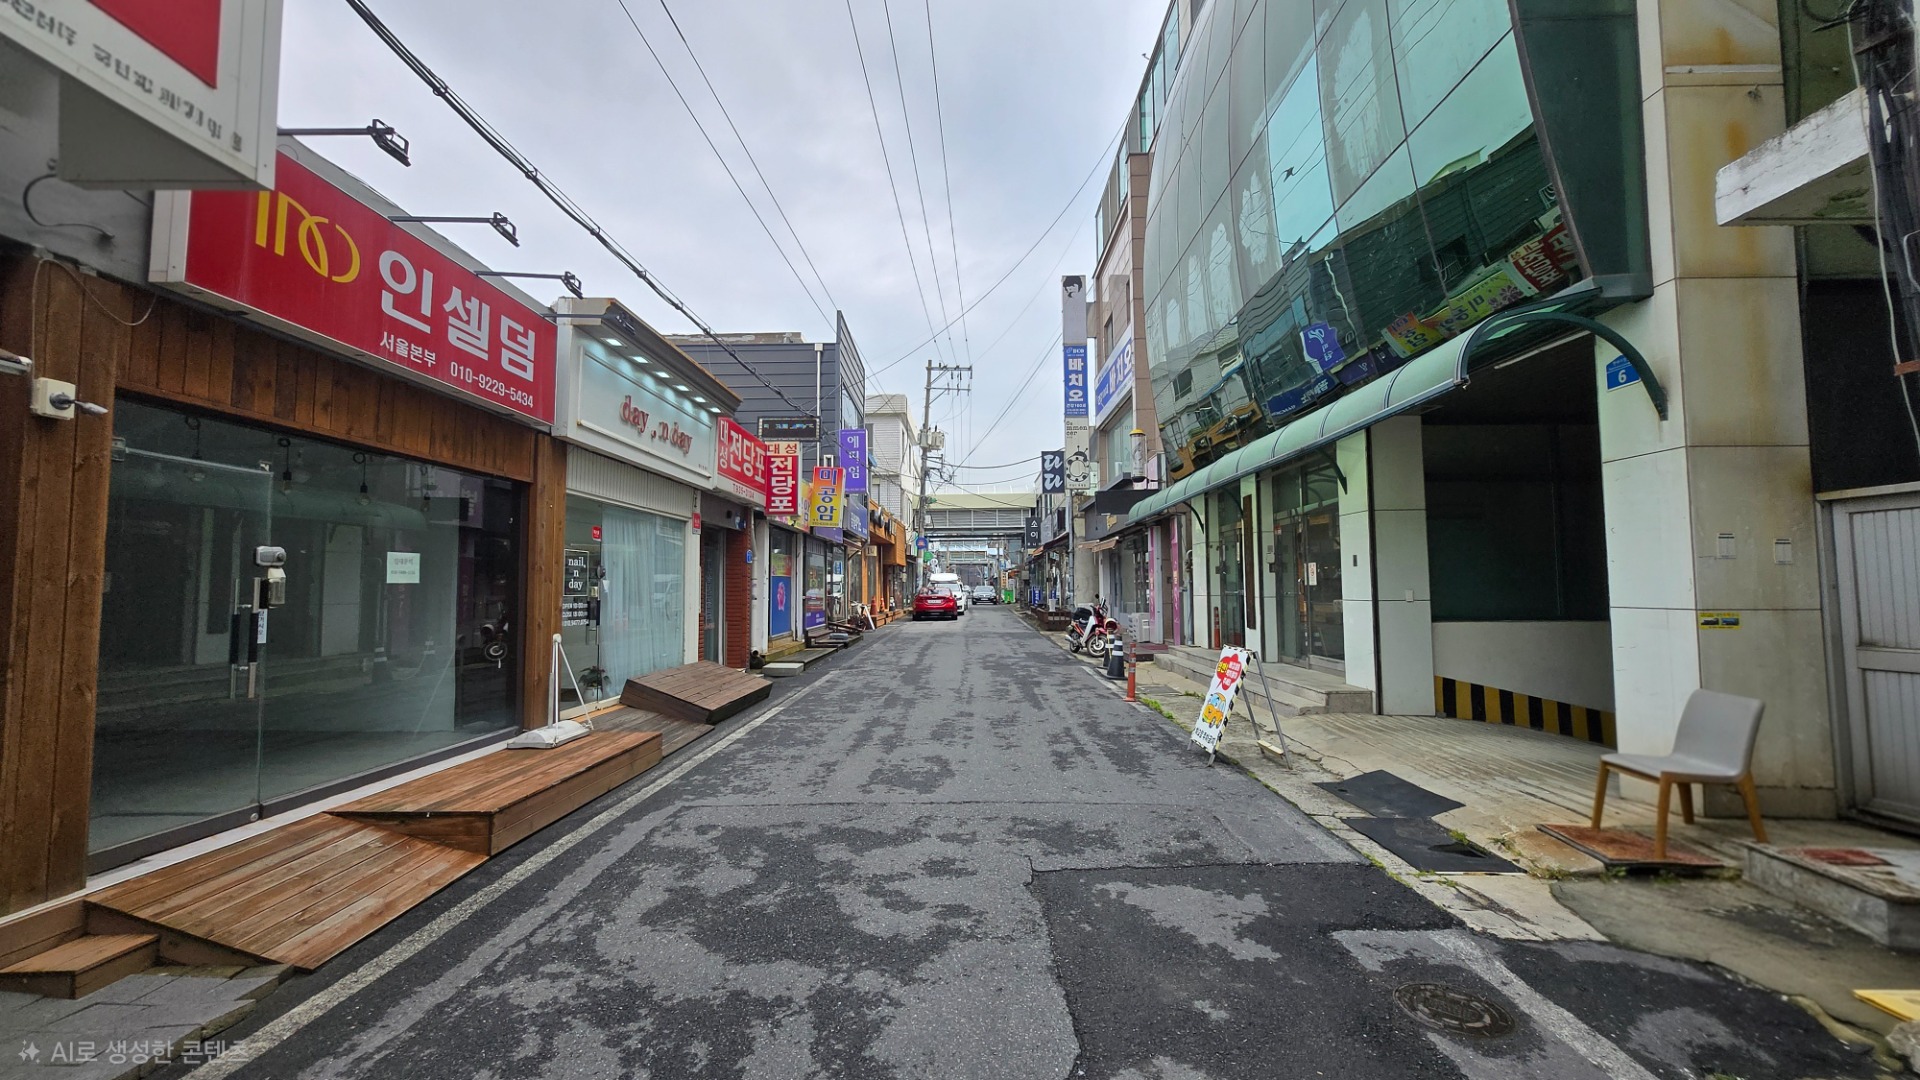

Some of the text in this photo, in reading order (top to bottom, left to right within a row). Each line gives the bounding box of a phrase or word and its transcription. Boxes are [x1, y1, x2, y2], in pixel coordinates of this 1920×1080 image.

[379, 250, 536, 382] 인셀덤
[380, 331, 534, 408] 서울본부 010-9229-5434
[1618, 369, 1627, 383] 6
[671, 421, 694, 456] day
[719, 418, 729, 470] 대성
[729, 430, 766, 485] 전당포
[767, 443, 798, 455] 대성
[769, 456, 796, 513] 전당포
[816, 469, 838, 521] 미공암
[1030, 520, 1039, 539] 소이
[568, 578, 583, 590] day
[573, 569, 579, 577] n
